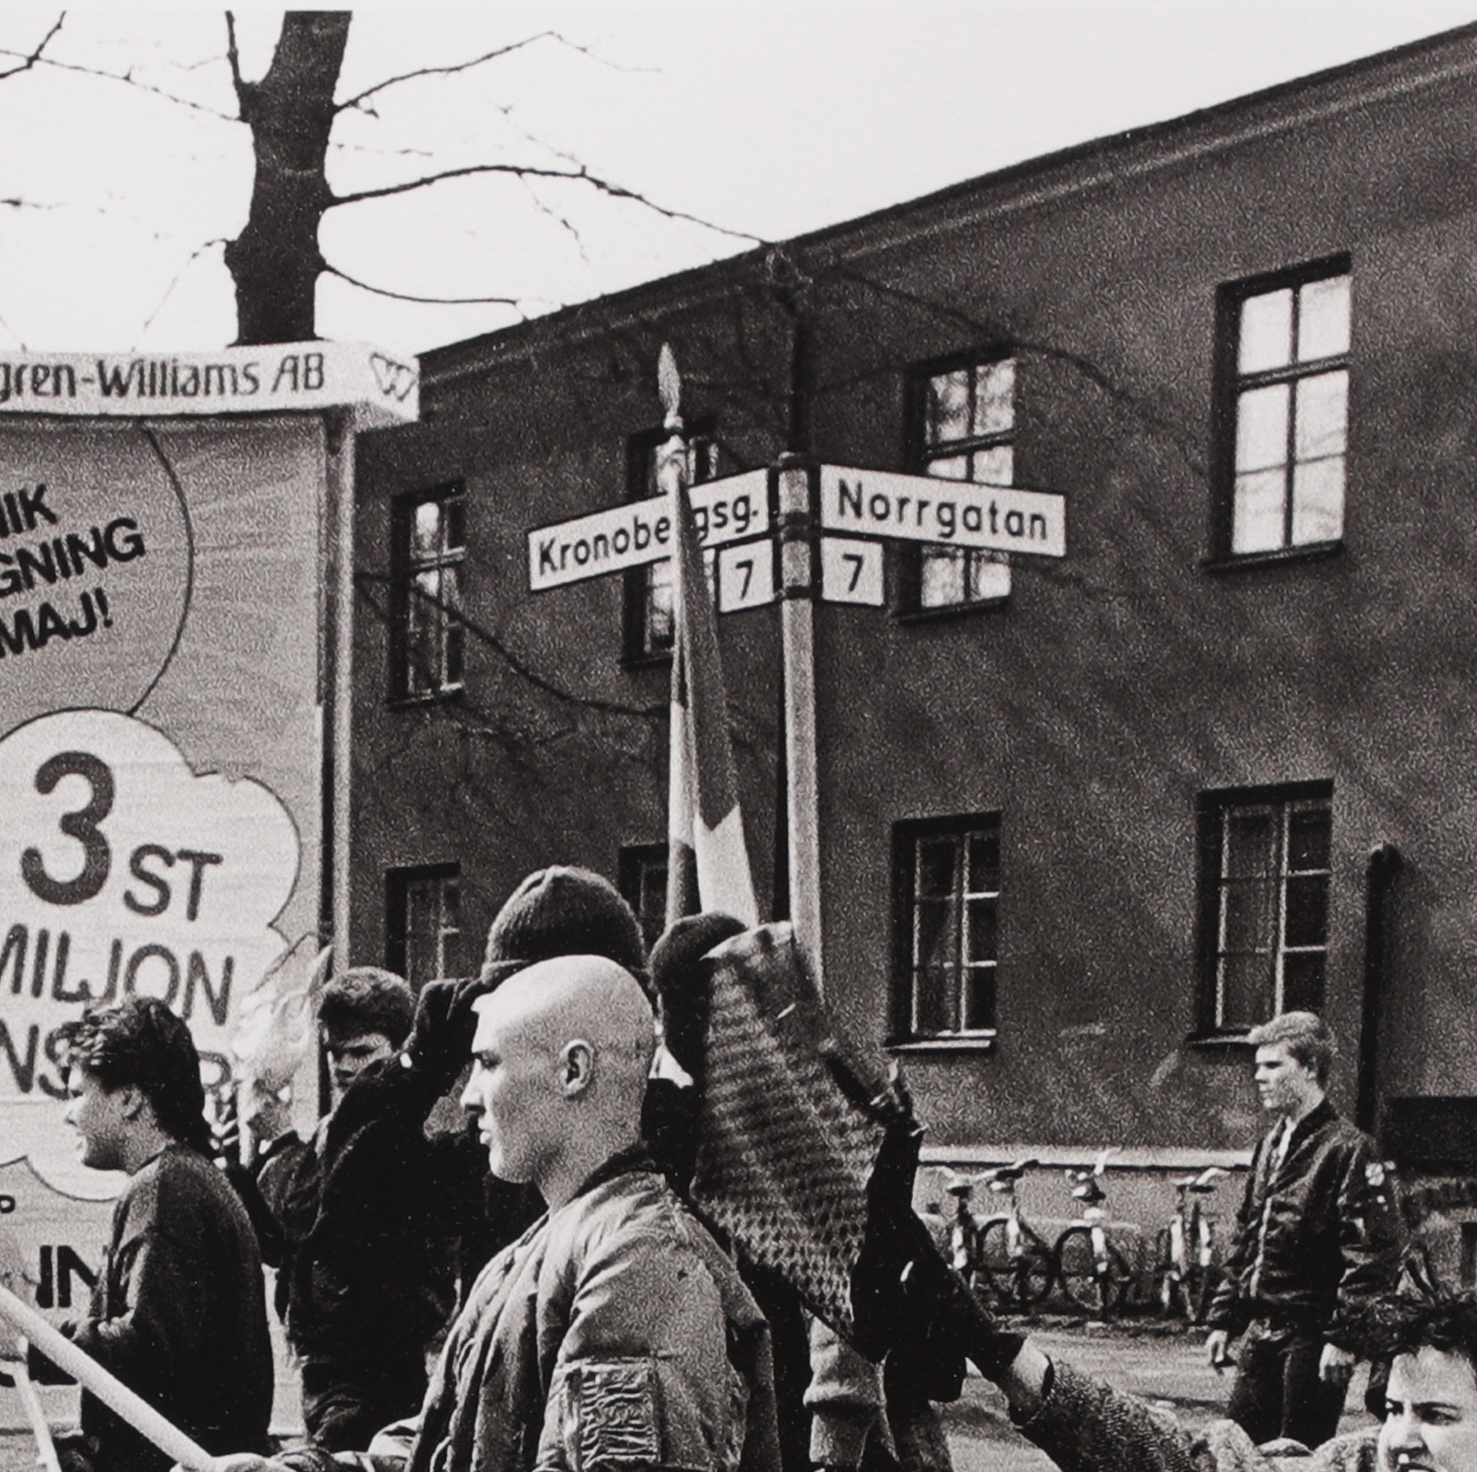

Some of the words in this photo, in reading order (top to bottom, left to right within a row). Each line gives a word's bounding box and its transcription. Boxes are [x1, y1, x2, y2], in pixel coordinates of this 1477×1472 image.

[272, 352, 325, 391] AB
[838, 478, 1047, 541] Norrgatan
[538, 494, 760, 577] Kronobegsg.
[735, 559, 754, 600] 7
[842, 553, 864, 592] 7
